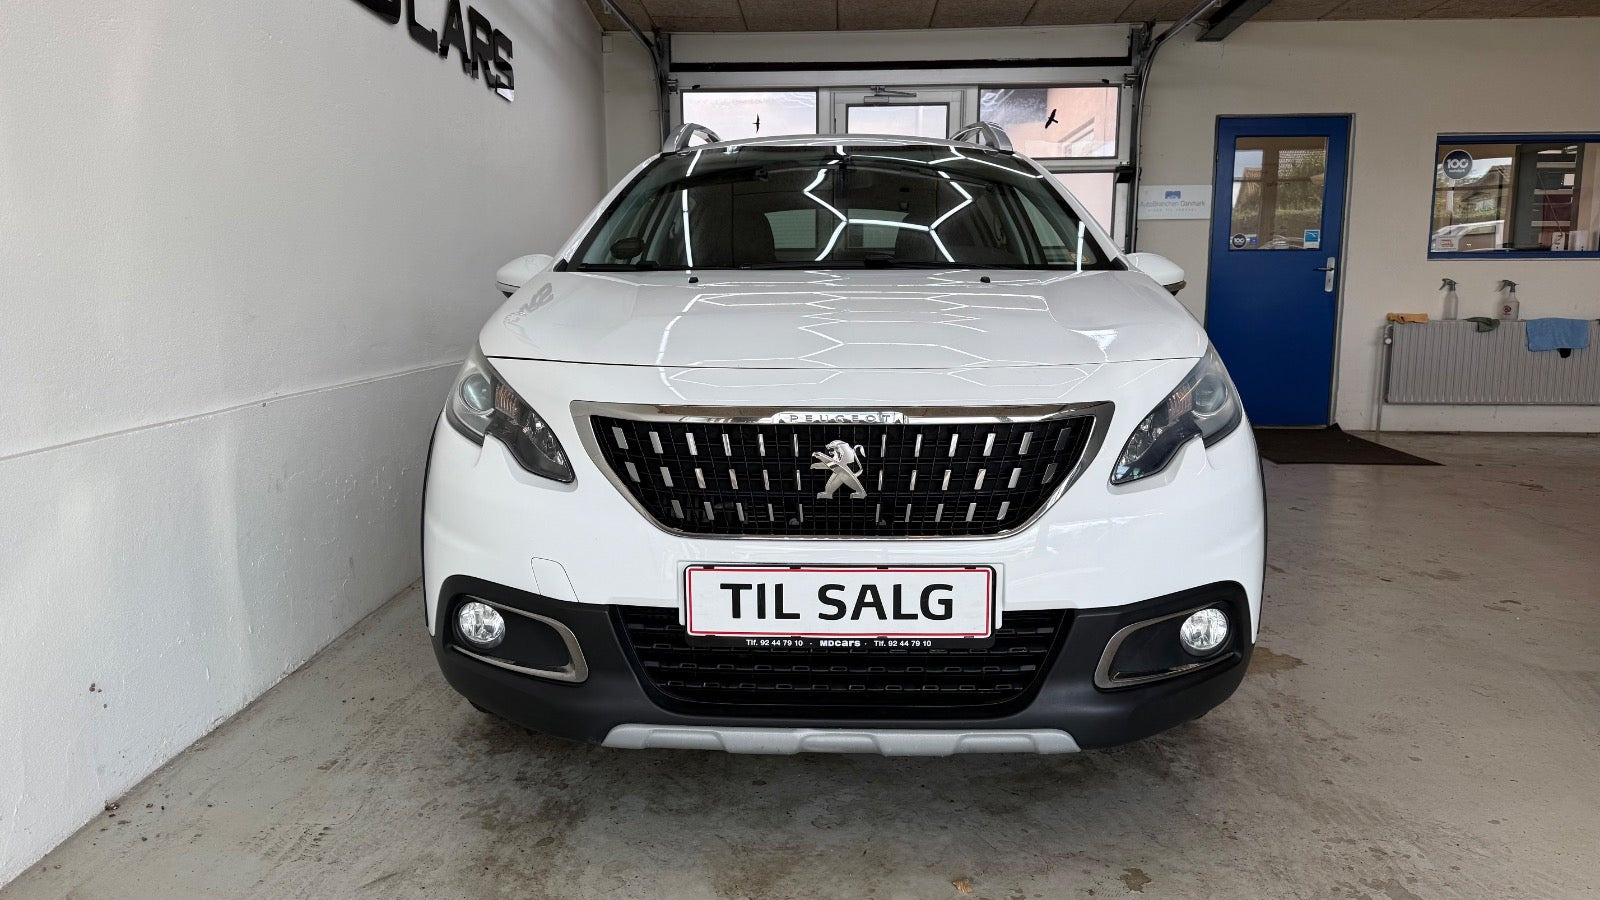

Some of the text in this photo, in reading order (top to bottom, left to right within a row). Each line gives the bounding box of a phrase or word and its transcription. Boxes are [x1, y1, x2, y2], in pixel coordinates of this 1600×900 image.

[789, 414, 891, 423] PEUGEOT
[720, 583, 954, 621] TIL SALG
